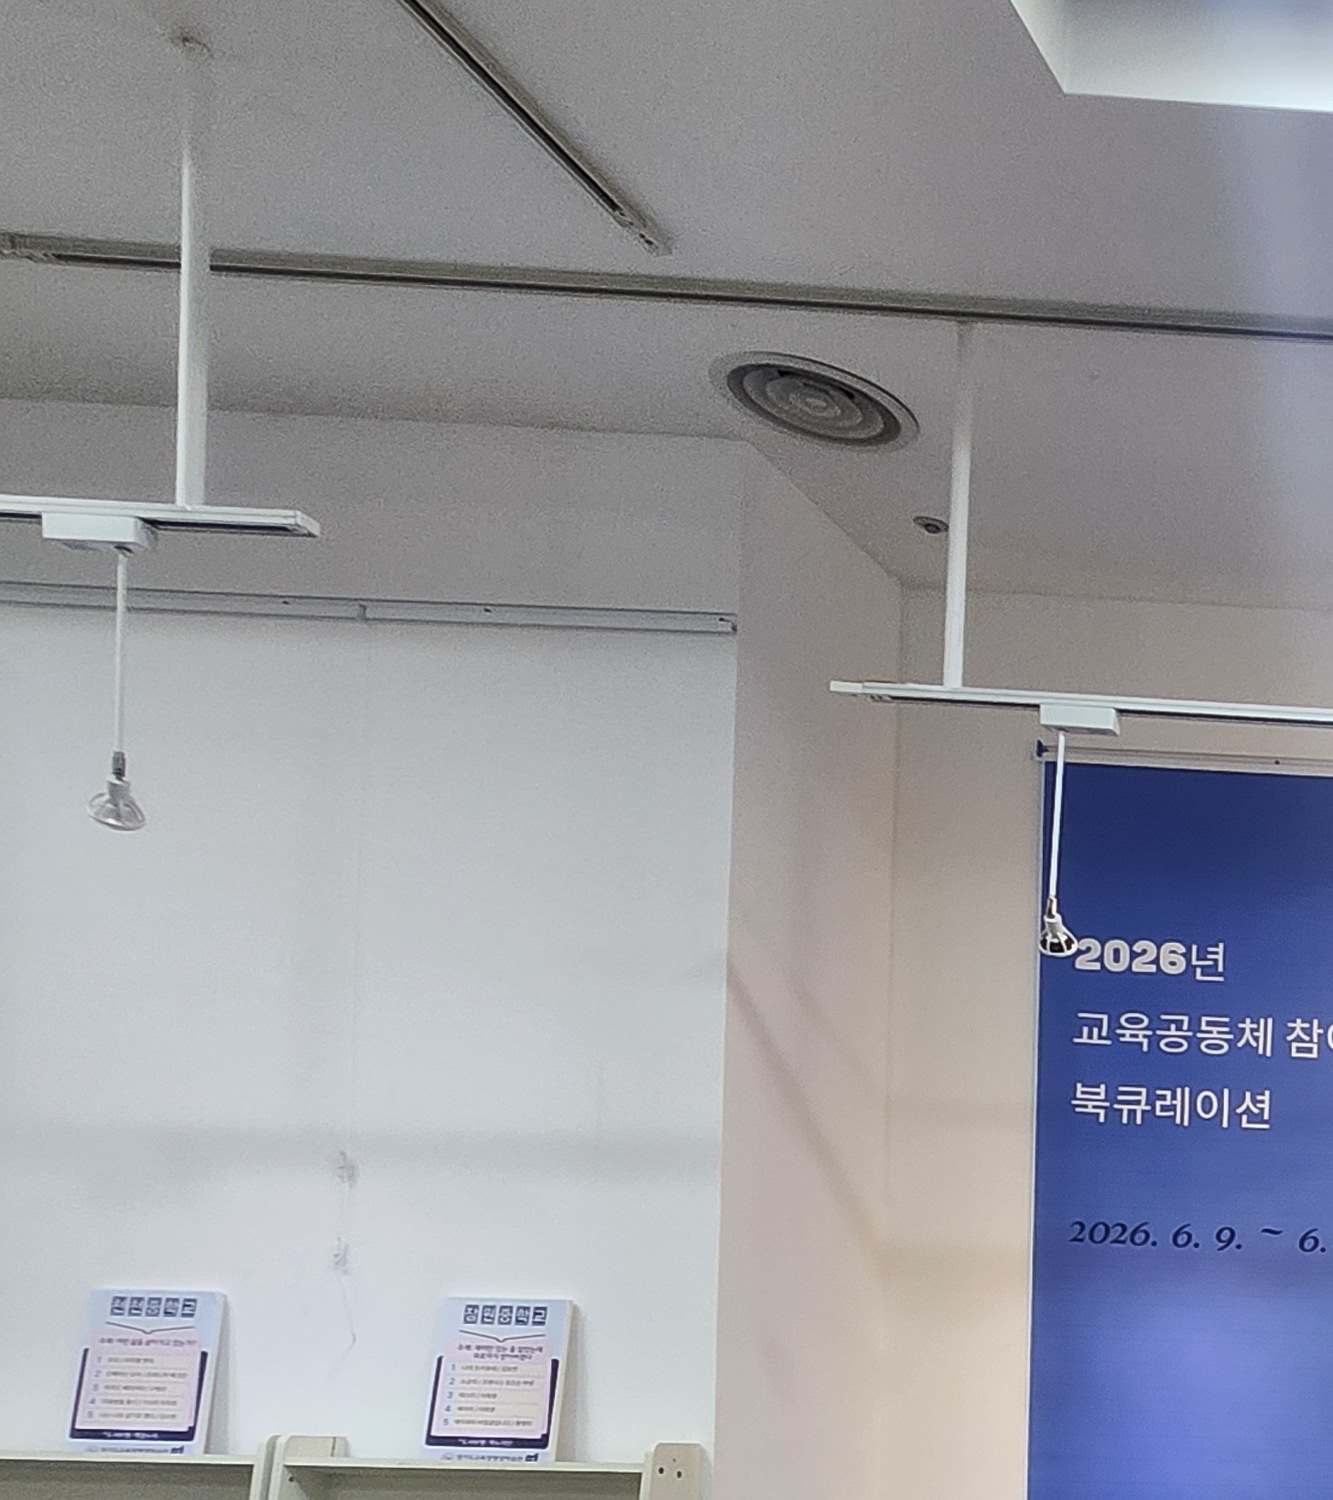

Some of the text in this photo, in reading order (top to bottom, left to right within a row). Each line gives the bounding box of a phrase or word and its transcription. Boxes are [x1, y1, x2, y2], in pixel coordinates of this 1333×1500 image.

[1073, 937, 1225, 983] 2026년
[1072, 1011, 1274, 1058] 교육공동체
[1070, 1081, 1272, 1130] 북큐레이션
[1067, 1219, 1159, 1248] 2026.
[1170, 1222, 1201, 1250] 6.
[1214, 1225, 1244, 1252] 9.
[1298, 1227, 1327, 1254] 6.
